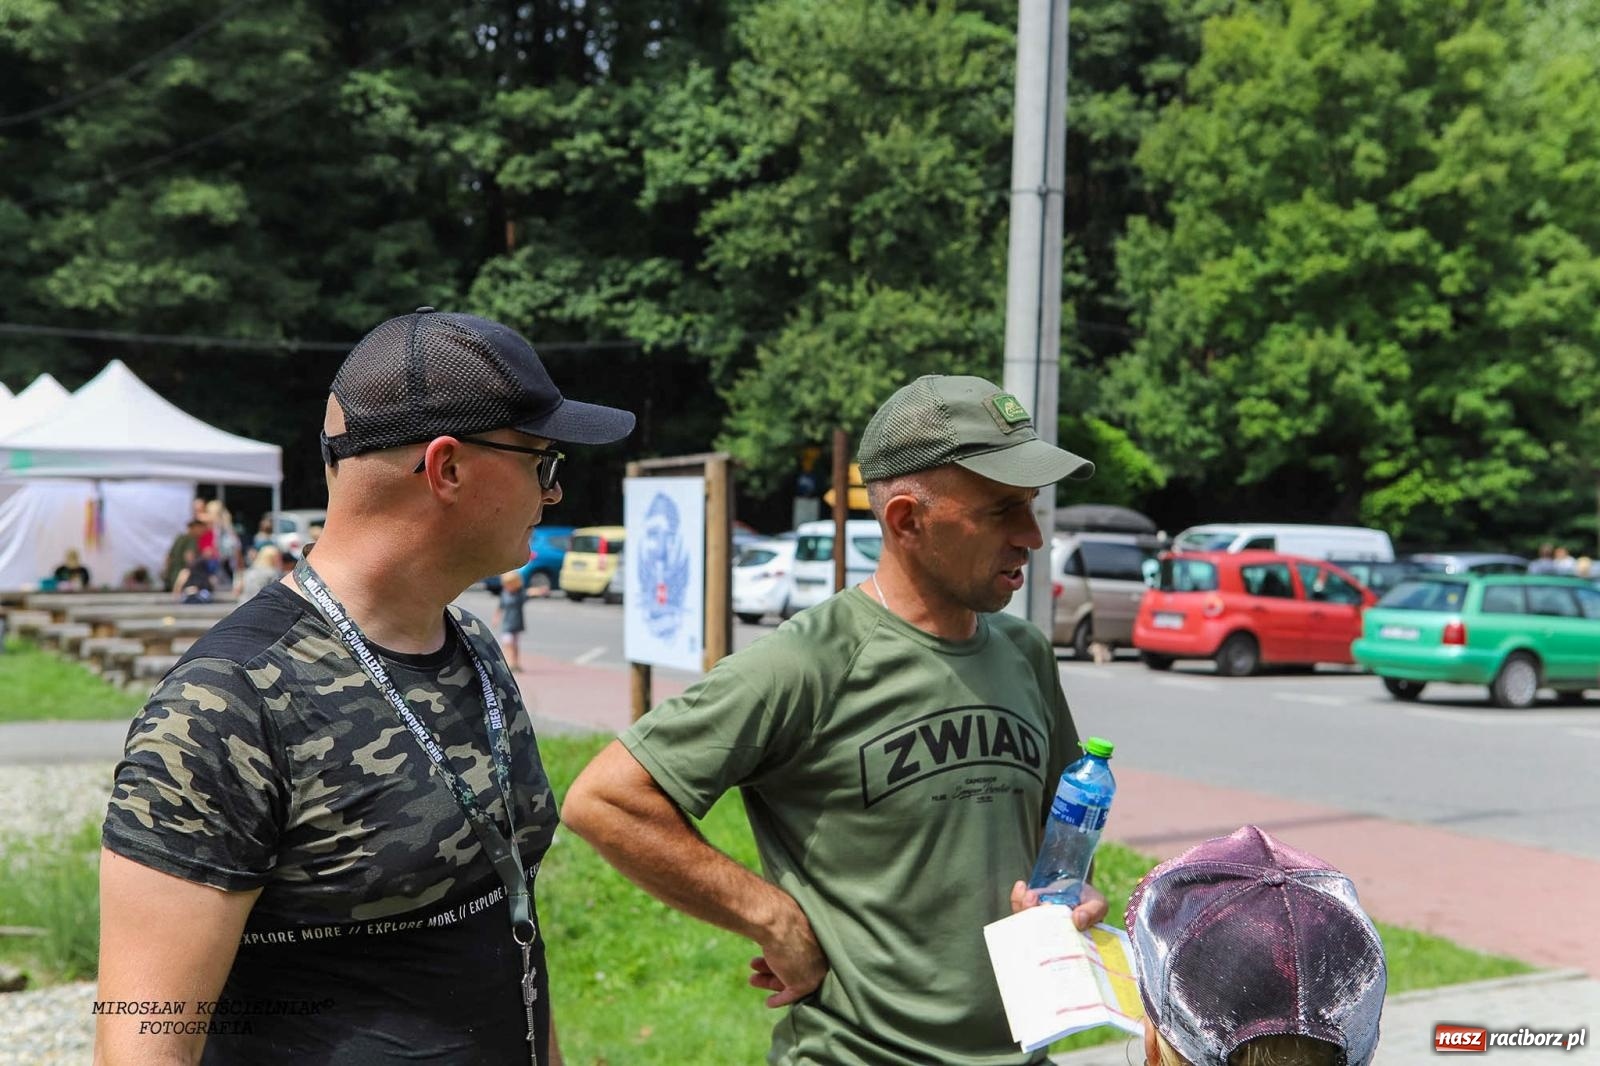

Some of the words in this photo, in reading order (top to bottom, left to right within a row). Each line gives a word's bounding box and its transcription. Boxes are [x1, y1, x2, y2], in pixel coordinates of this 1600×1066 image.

[303, 576, 343, 627] ARBORETUM
[338, 620, 353, 634] W
[345, 629, 389, 685] PRZETRWAĆ
[389, 687, 432, 742] ZWIADOWCY
[488, 708, 503, 730] BIEG
[426, 739, 443, 763] BIEG
[884, 714, 1041, 785] ZWIAD
[241, 930, 297, 944] XPLORE
[302, 926, 342, 941] MORE
[367, 920, 423, 935] EXPLORE
[428, 909, 458, 928] MORE
[469, 886, 503, 914] EXPLORE
